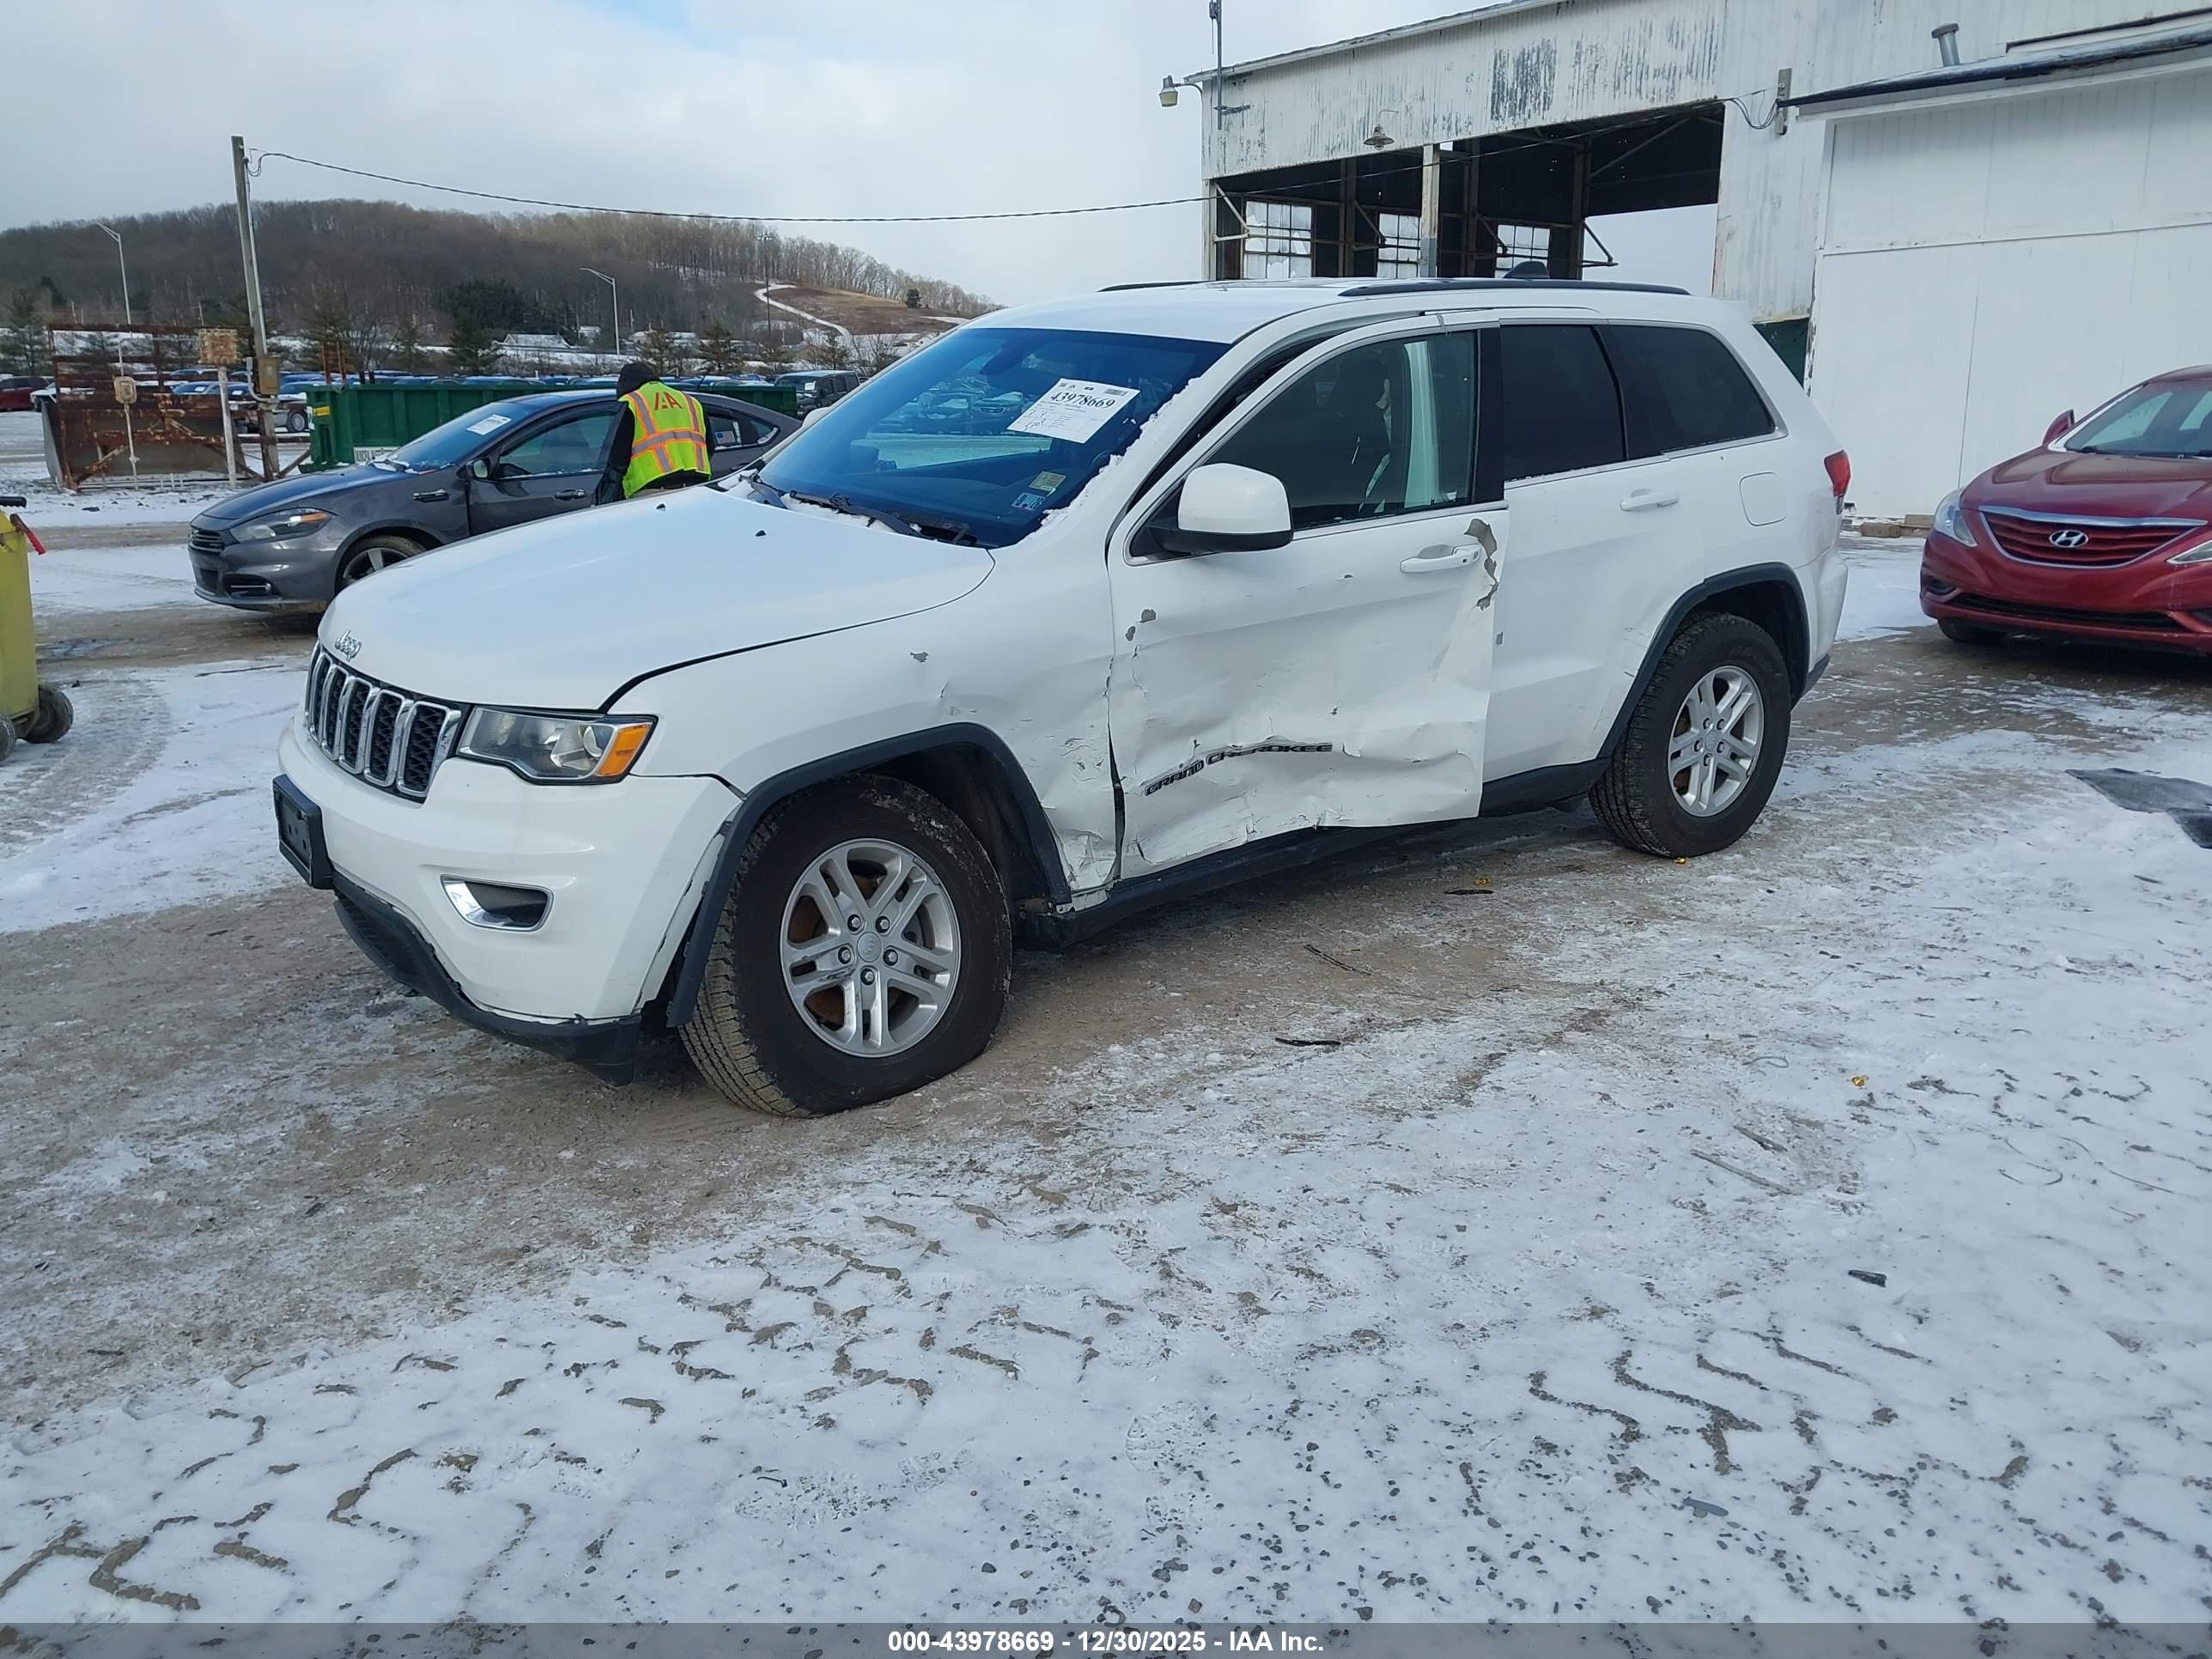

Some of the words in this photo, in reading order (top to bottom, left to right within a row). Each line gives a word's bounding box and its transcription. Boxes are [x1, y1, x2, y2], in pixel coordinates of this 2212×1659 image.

[1050, 391, 1116, 409] 43978669
[334, 629, 362, 662] Jeep
[1145, 759, 1205, 796] GRAND
[1206, 744, 1334, 765] CHEROKEE
